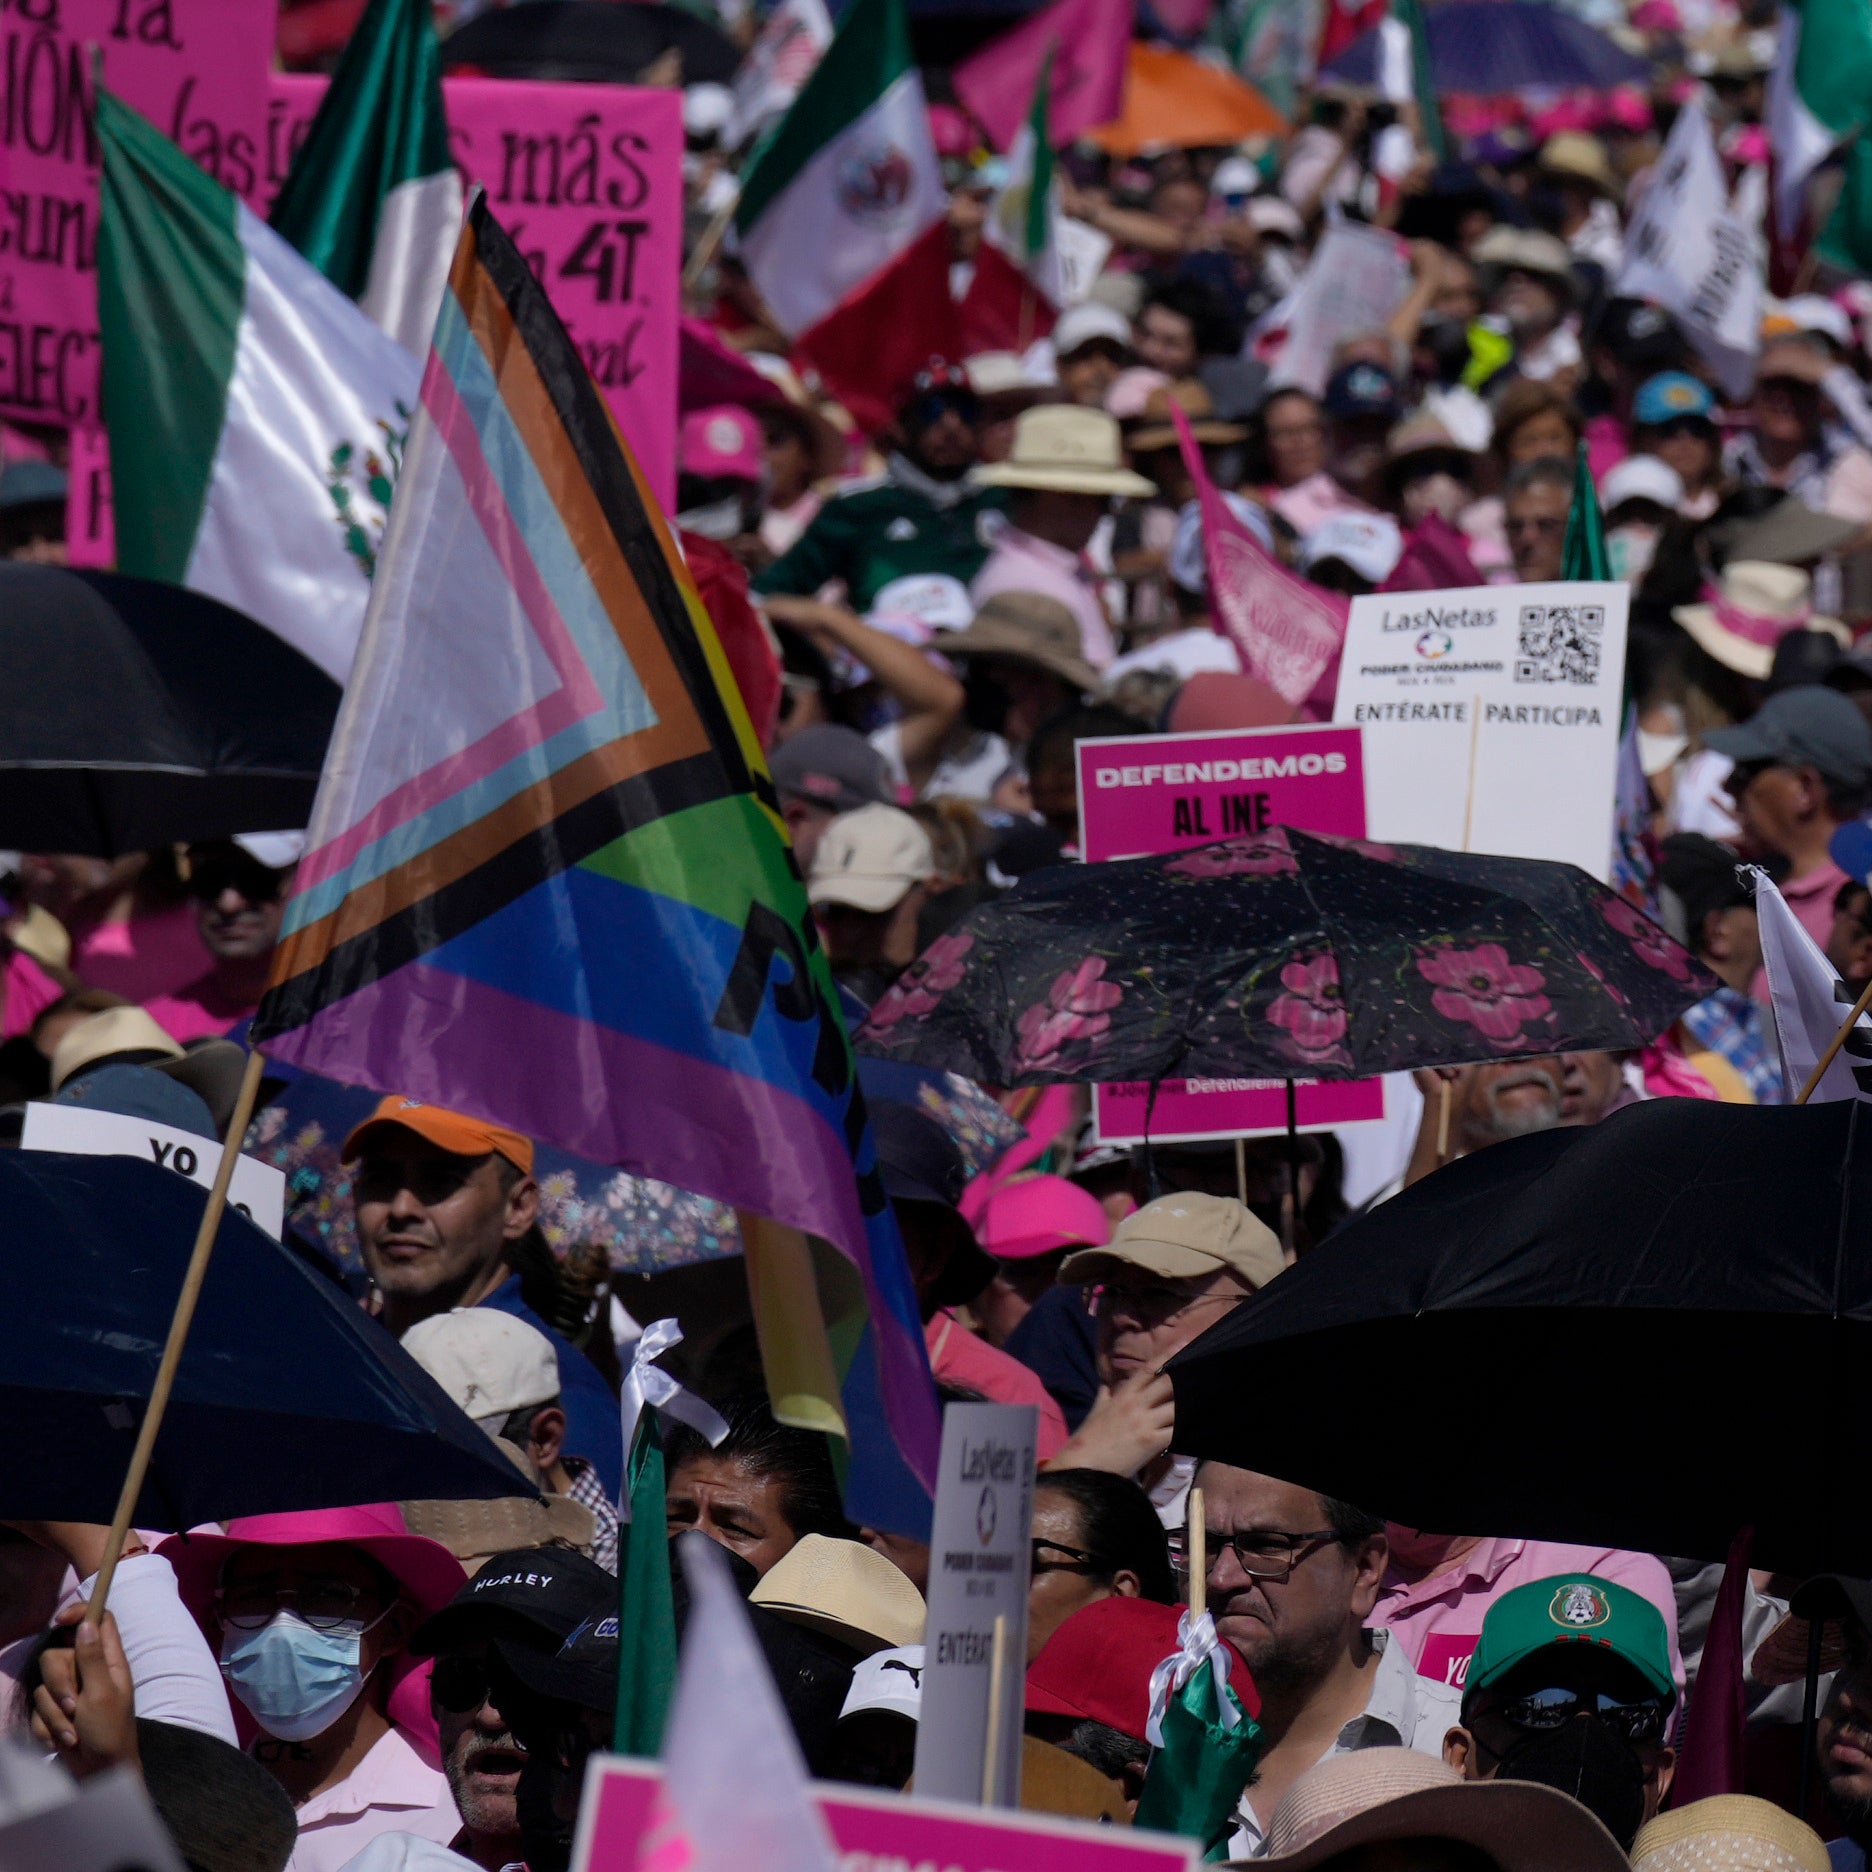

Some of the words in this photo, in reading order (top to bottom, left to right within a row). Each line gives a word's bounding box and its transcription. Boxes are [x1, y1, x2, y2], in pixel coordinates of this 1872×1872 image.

[498, 113, 648, 211] más
[1382, 608, 1497, 633] LasNetas
[1354, 699, 1467, 723] ENTÉRATE
[1485, 702, 1603, 726] PARTICIPA
[1095, 752, 1347, 789] DEFENDEMOS
[1173, 797, 1209, 837] AL
[1220, 792, 1271, 833] INE
[150, 1137, 197, 1176] YO
[473, 1572, 554, 1593] HURLEY
